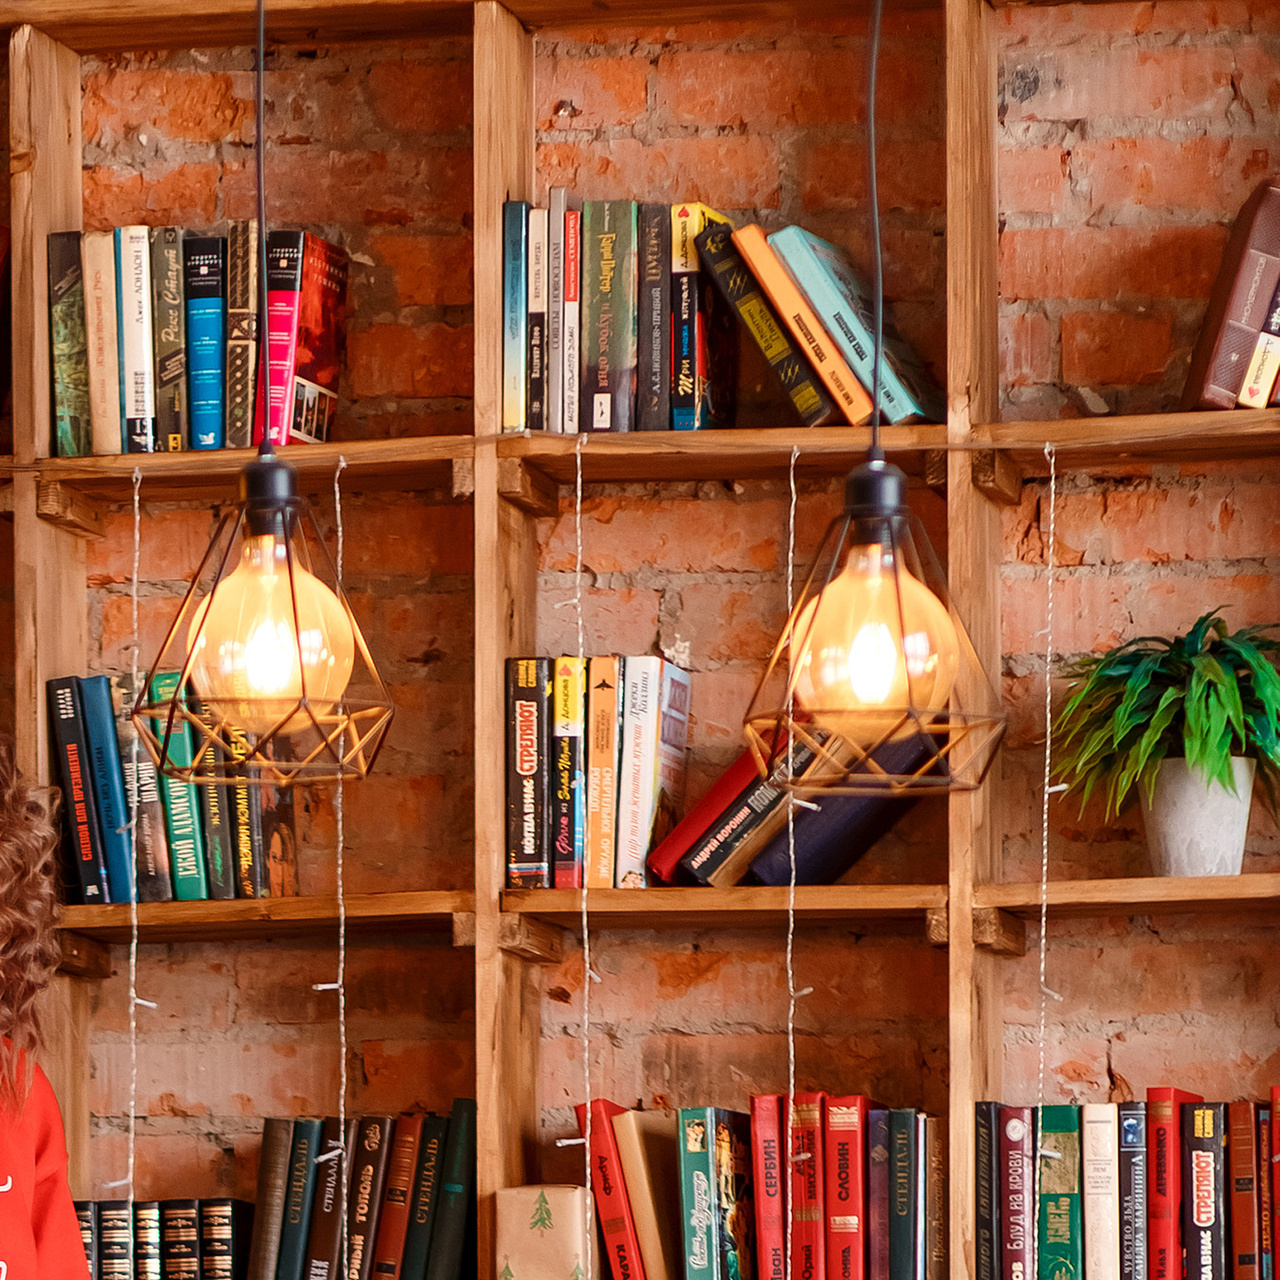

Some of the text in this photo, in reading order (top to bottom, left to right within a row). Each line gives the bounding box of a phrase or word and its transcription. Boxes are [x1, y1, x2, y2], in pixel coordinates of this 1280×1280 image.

[568, 214, 576, 260] СЕМЕНОВА
[645, 216, 663, 282] ЦУСИМА
[133, 249, 144, 294] ЛОНДОН
[162, 248, 182, 342] Рекс Стаут
[552, 242, 561, 350] СОВЕТЫ НОВОСЕЛАМ
[596, 233, 616, 387] Гарри Поттер Кубок огня
[746, 308, 772, 352] Валентин
[678, 360, 692, 396] Три
[560, 679, 570, 719] Донцова
[629, 682, 640, 719] Джеки
[639, 671, 650, 714] Коллинз
[517, 702, 538, 773] СТРЕЛЯЮТ
[630, 724, 645, 809] женатых мужчин
[66, 743, 92, 860] СЛЕПОЙ ДЛЯ ПРЕЗИДЕНТА
[137, 762, 158, 802] ШАРНИ
[590, 768, 600, 812] РОБОКОП
[598, 767, 612, 878] СМЕРТЕЛЬНОЕ ОРУЖИЕ
[690, 806, 751, 870] АНДРЕЙ ВОРОНИН
[172, 838, 200, 878] ДЖОЙ
[289, 1138, 309, 1224] СТЕНДАЛЬ
[356, 1164, 374, 1223] ТОПОЛЬ
[415, 1138, 438, 1224] СТЕНДАЛЬ
[598, 1155, 614, 1196] Ариф
[764, 1138, 778, 1198] СЕРБИН
[838, 1142, 850, 1201] СЛОВИН
[896, 1128, 910, 1216] СТЕНДАЛЬ
[976, 1117, 990, 1220] аппетита!
[1008, 1150, 1023, 1191] крови
[1132, 1155, 1144, 1228] МАРИНИНА
[1192, 1150, 1215, 1227] СТРЕЛЯЮТ
[1007, 1214, 1026, 1250] Блуд
[1010, 1194, 1023, 1210] на
[1046, 1196, 1071, 1244] ХМЕЛЬ
[1156, 1127, 1168, 1278] Илья ДЕРЕВЯНКО
[1124, 1195, 1132, 1274] ЧУВСТВО ЛЬДА
